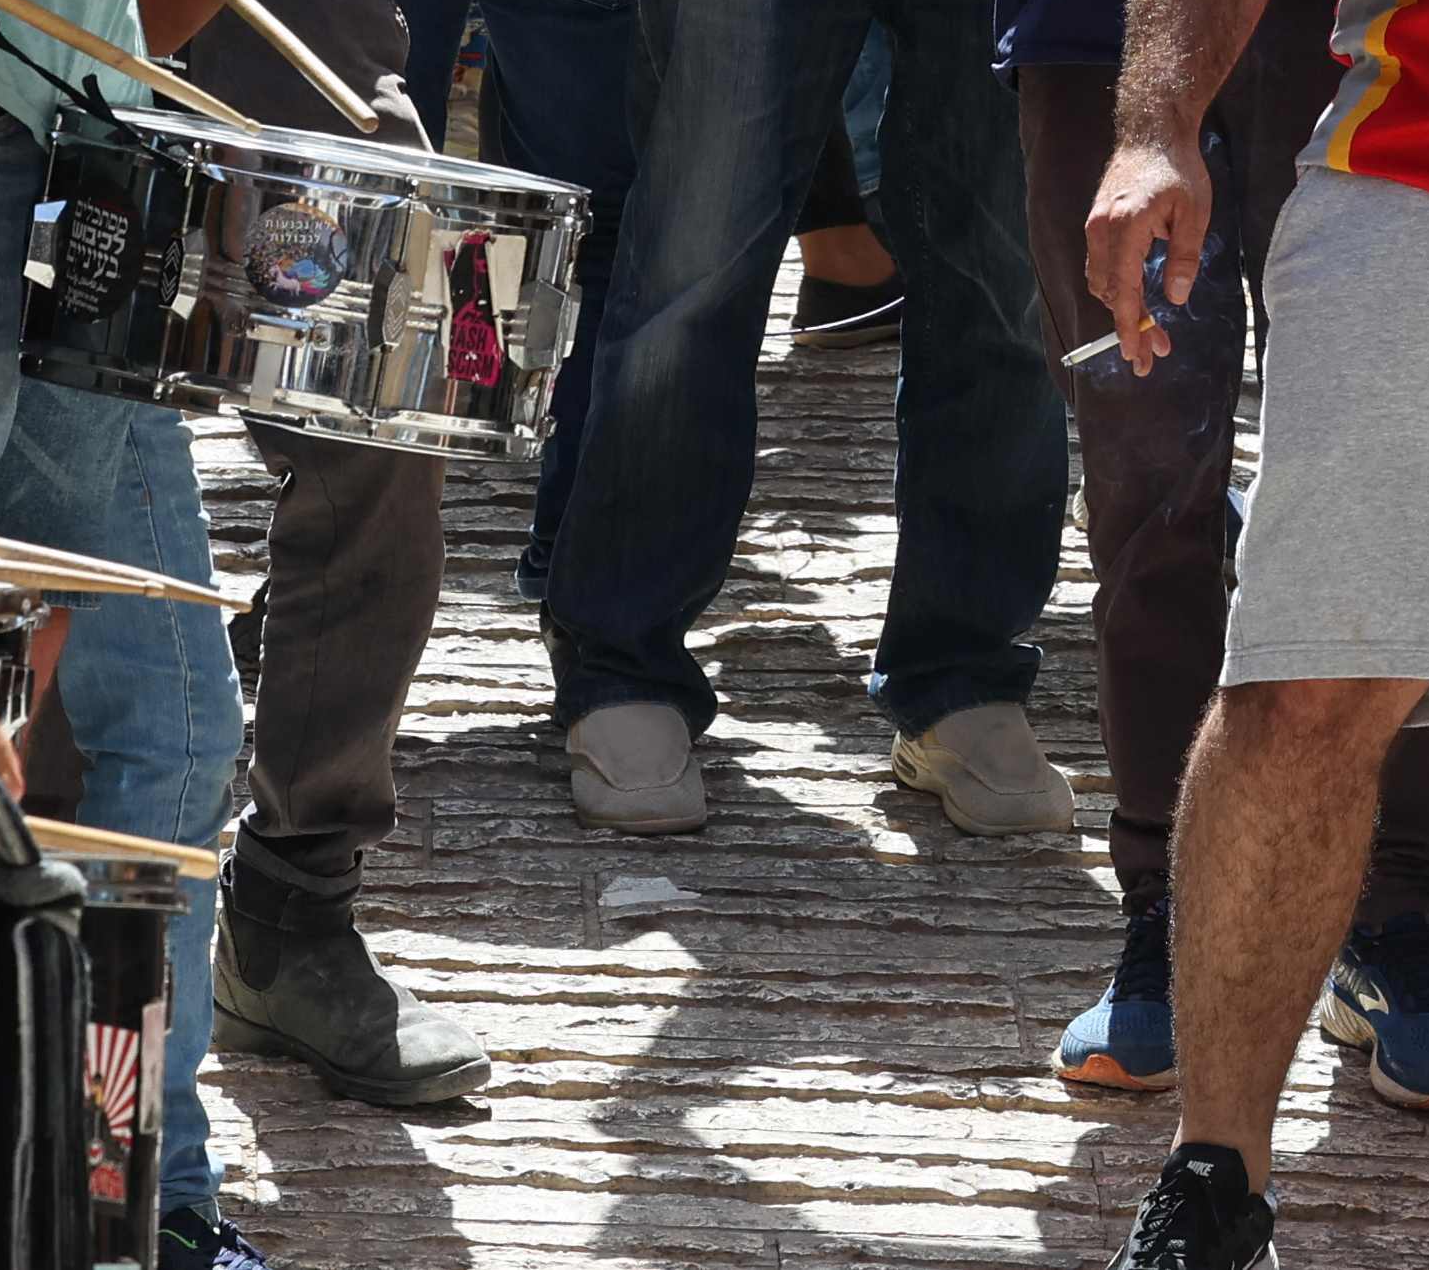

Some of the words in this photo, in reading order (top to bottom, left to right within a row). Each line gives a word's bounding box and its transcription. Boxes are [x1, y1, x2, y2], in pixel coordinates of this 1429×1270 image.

[71, 219, 126, 256] לכיבוש
[66, 239, 119, 279] בעיניים
[1186, 1159, 1215, 1177] NIKE
